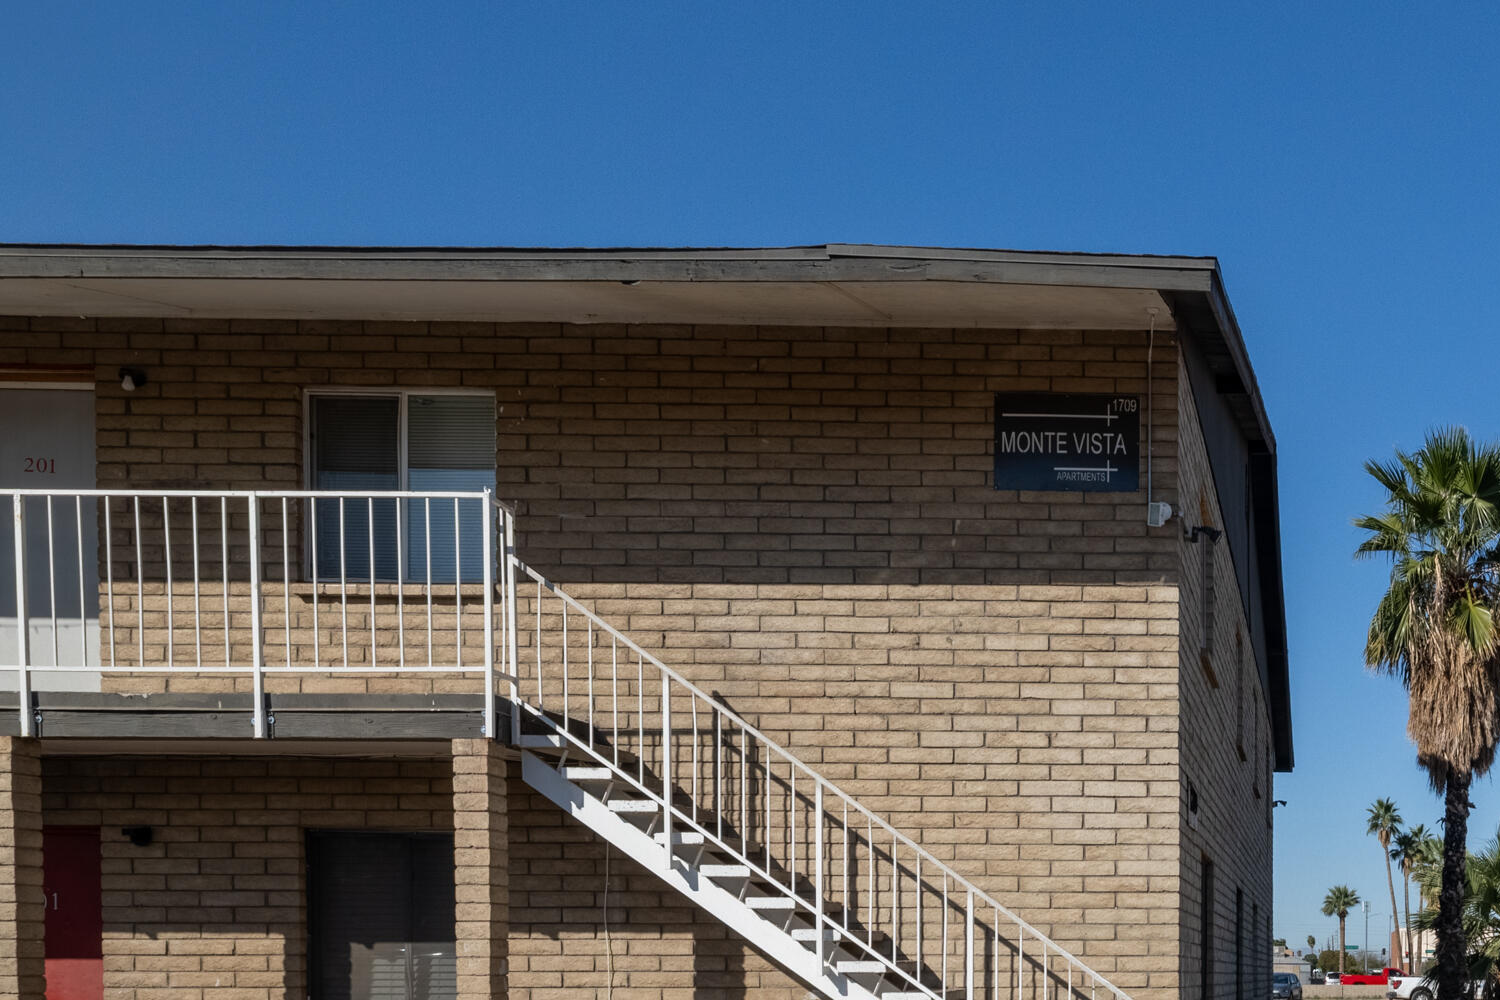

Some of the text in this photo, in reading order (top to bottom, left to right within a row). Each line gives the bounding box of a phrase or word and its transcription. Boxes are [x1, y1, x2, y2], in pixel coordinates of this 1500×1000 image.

[1113, 399, 1137, 412] 1709
[1001, 431, 1128, 456] MONTE VISTA
[23, 457, 56, 474] 201
[1056, 472, 1106, 482] APARTMENTS
